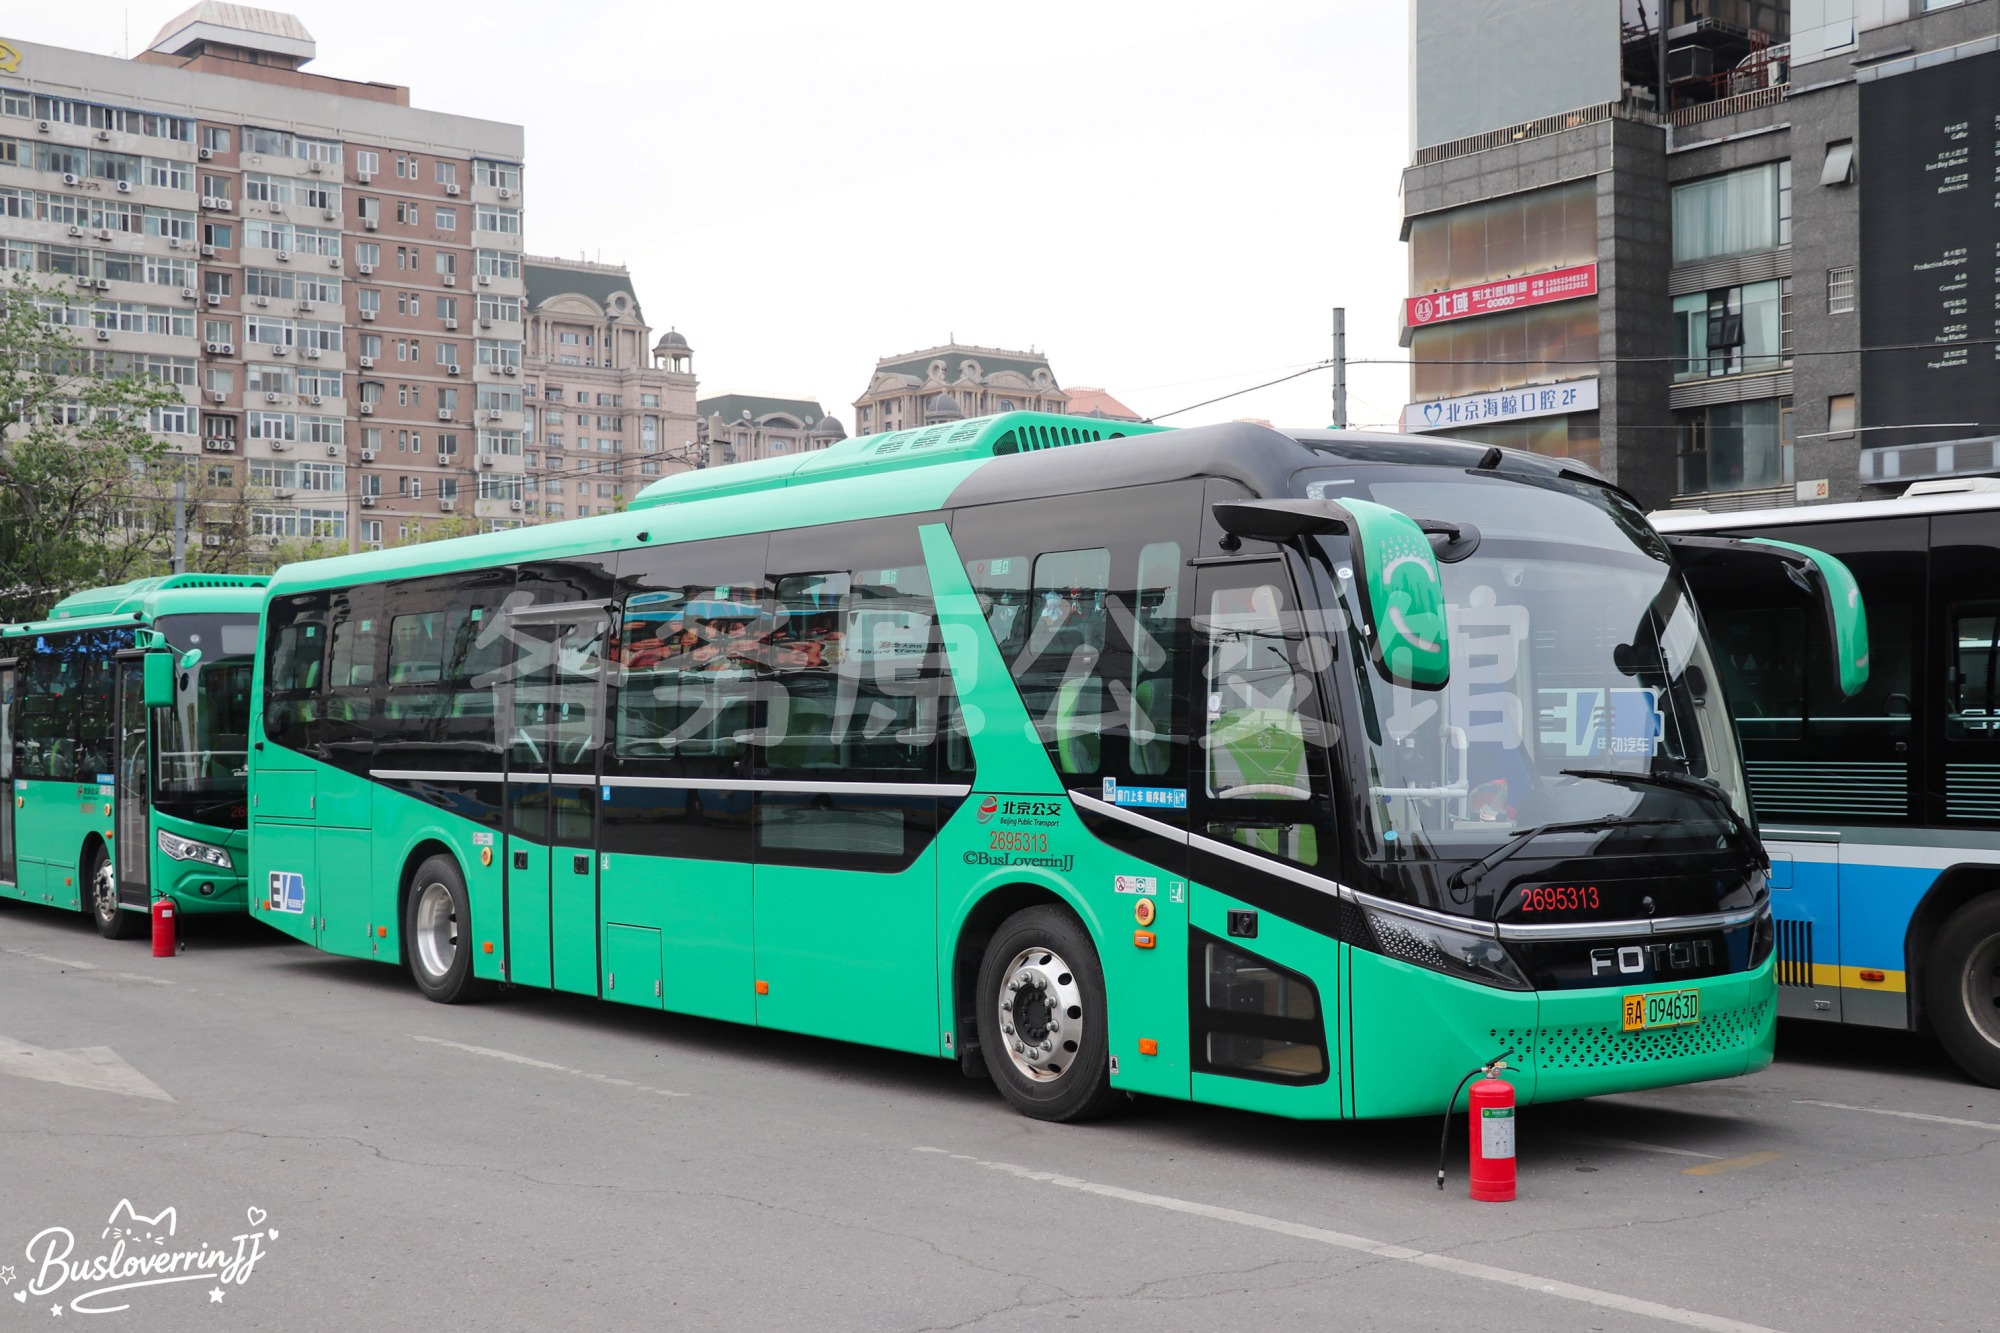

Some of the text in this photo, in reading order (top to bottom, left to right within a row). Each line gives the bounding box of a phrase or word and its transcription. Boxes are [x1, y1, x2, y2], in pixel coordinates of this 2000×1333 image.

[1446, 388, 1577, 422] 北京海鲸口腔 2F
[1002, 801, 1062, 816] 北京公交
[1000, 817, 1059, 828] Beijing Public Transport
[990, 830, 1048, 853] 2695313
[1520, 886, 1600, 912] 2695313
